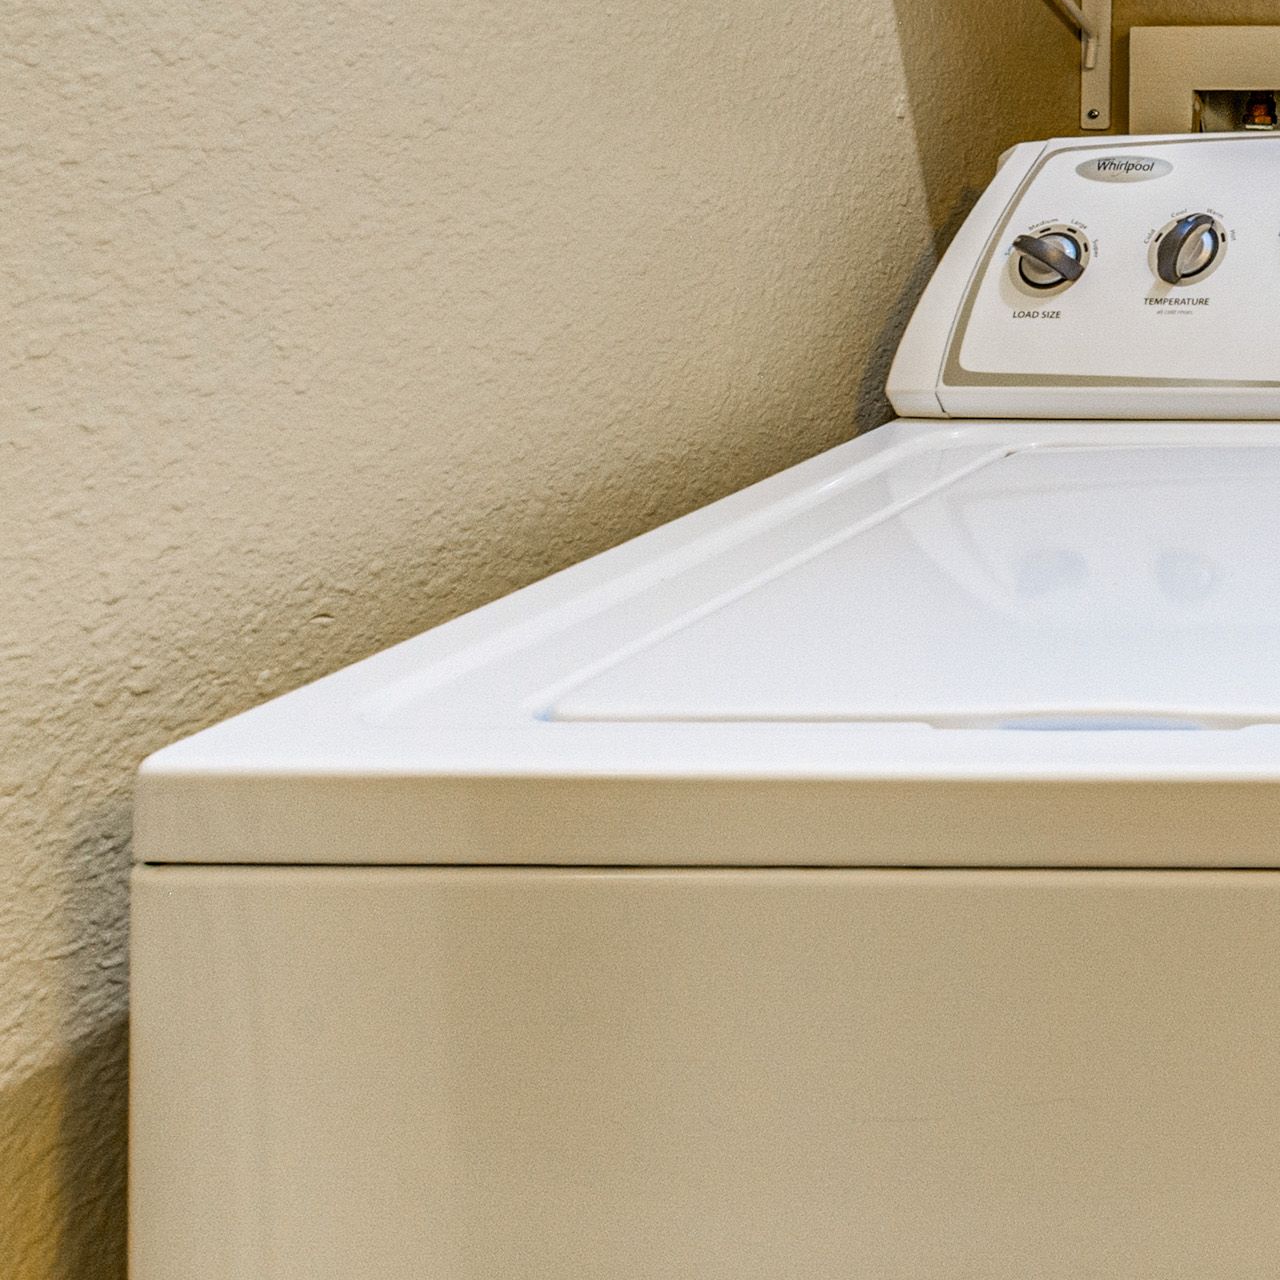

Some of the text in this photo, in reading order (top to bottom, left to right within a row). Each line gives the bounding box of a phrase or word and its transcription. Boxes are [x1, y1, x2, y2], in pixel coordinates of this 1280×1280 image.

[1097, 160, 1155, 174] Whirlpool
[1143, 297, 1211, 306] TEMPERATURE
[1012, 311, 1062, 319] LOAD SIZE
